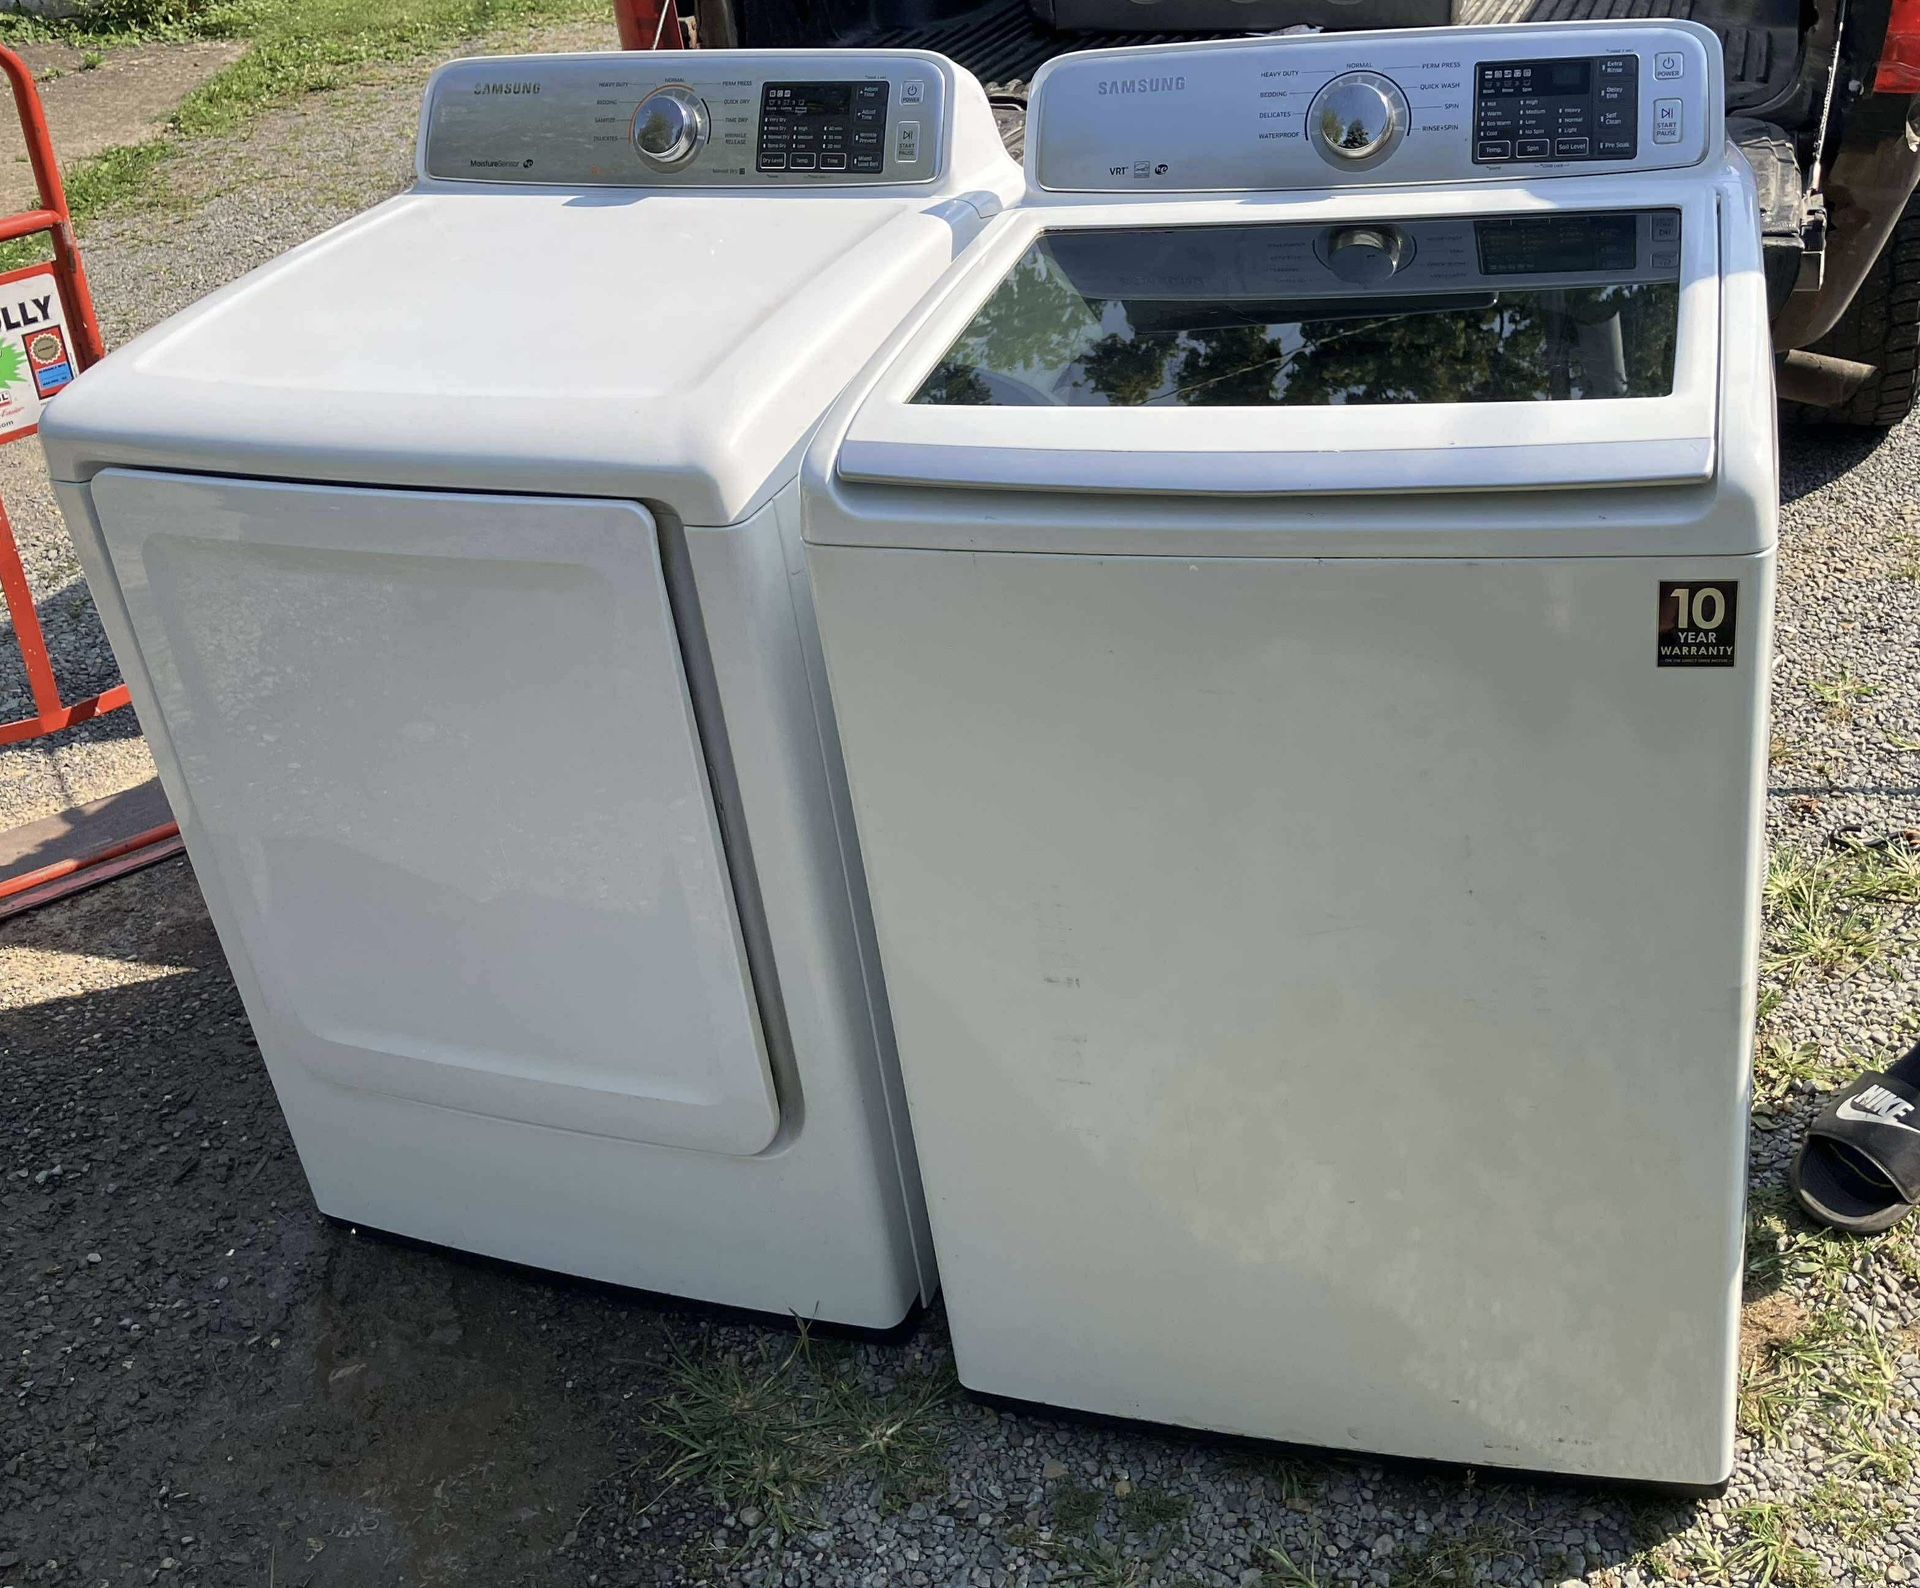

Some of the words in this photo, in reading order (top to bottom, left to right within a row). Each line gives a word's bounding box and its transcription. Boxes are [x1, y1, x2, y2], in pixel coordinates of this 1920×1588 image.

[474, 82, 541, 95] SAMSUNG
[1098, 77, 1185, 95] SAMSUNG
[1259, 111, 1291, 119] DELICATES
[470, 159, 519, 167] MoistureSensor
[0, 295, 51, 332] LLY
[1670, 587, 1725, 630] 10
[1678, 632, 1717, 643] YEAR
[1660, 646, 1733, 656] WARRANTY
[1854, 1084, 1915, 1121] NIKE
